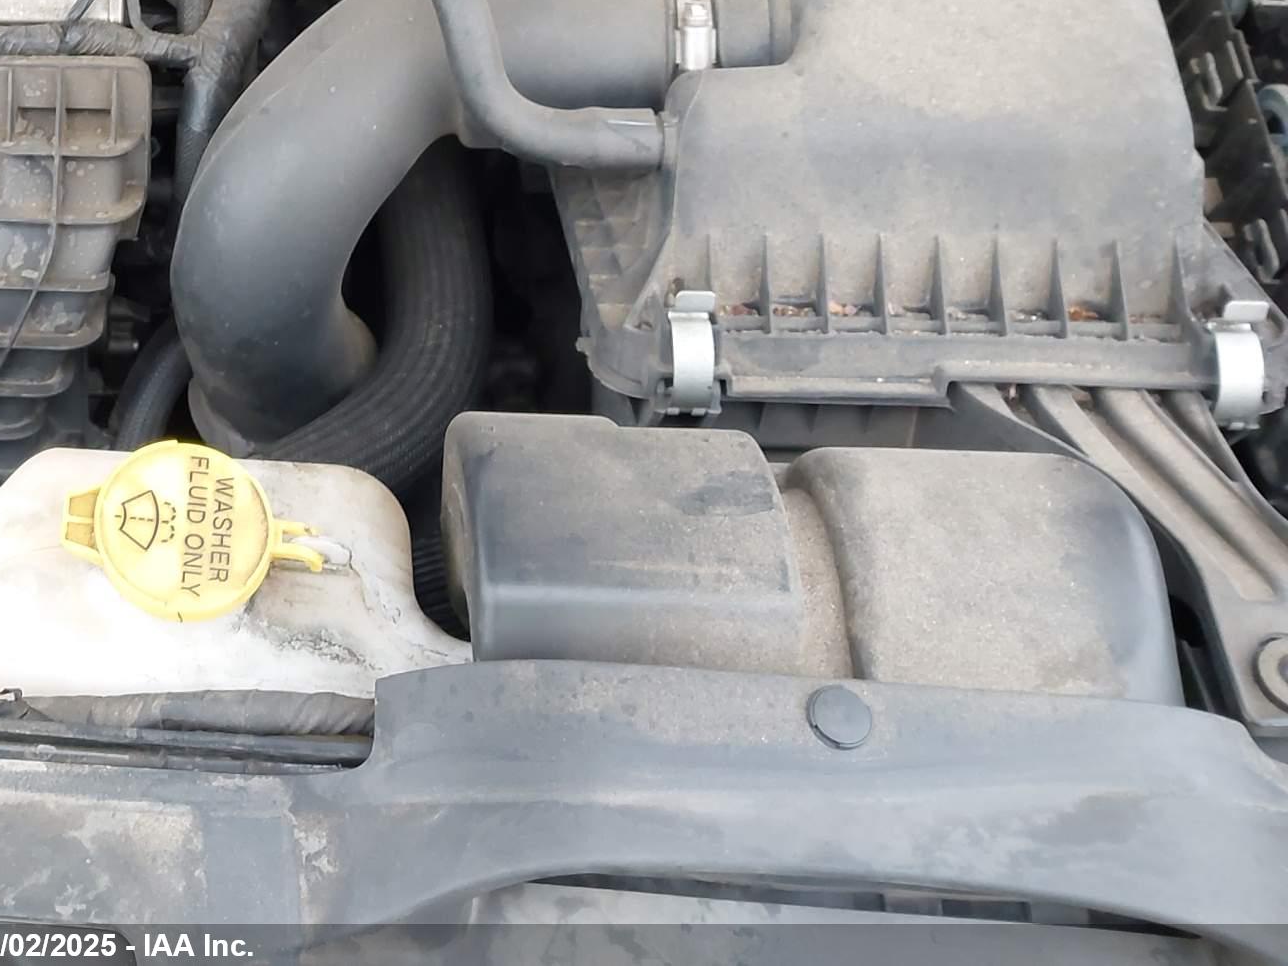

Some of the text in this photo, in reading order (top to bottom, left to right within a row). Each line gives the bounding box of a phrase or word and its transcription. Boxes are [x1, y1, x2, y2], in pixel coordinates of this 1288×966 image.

[182, 456, 209, 596] FLUID ONLY
[208, 478, 234, 582] WASHER
